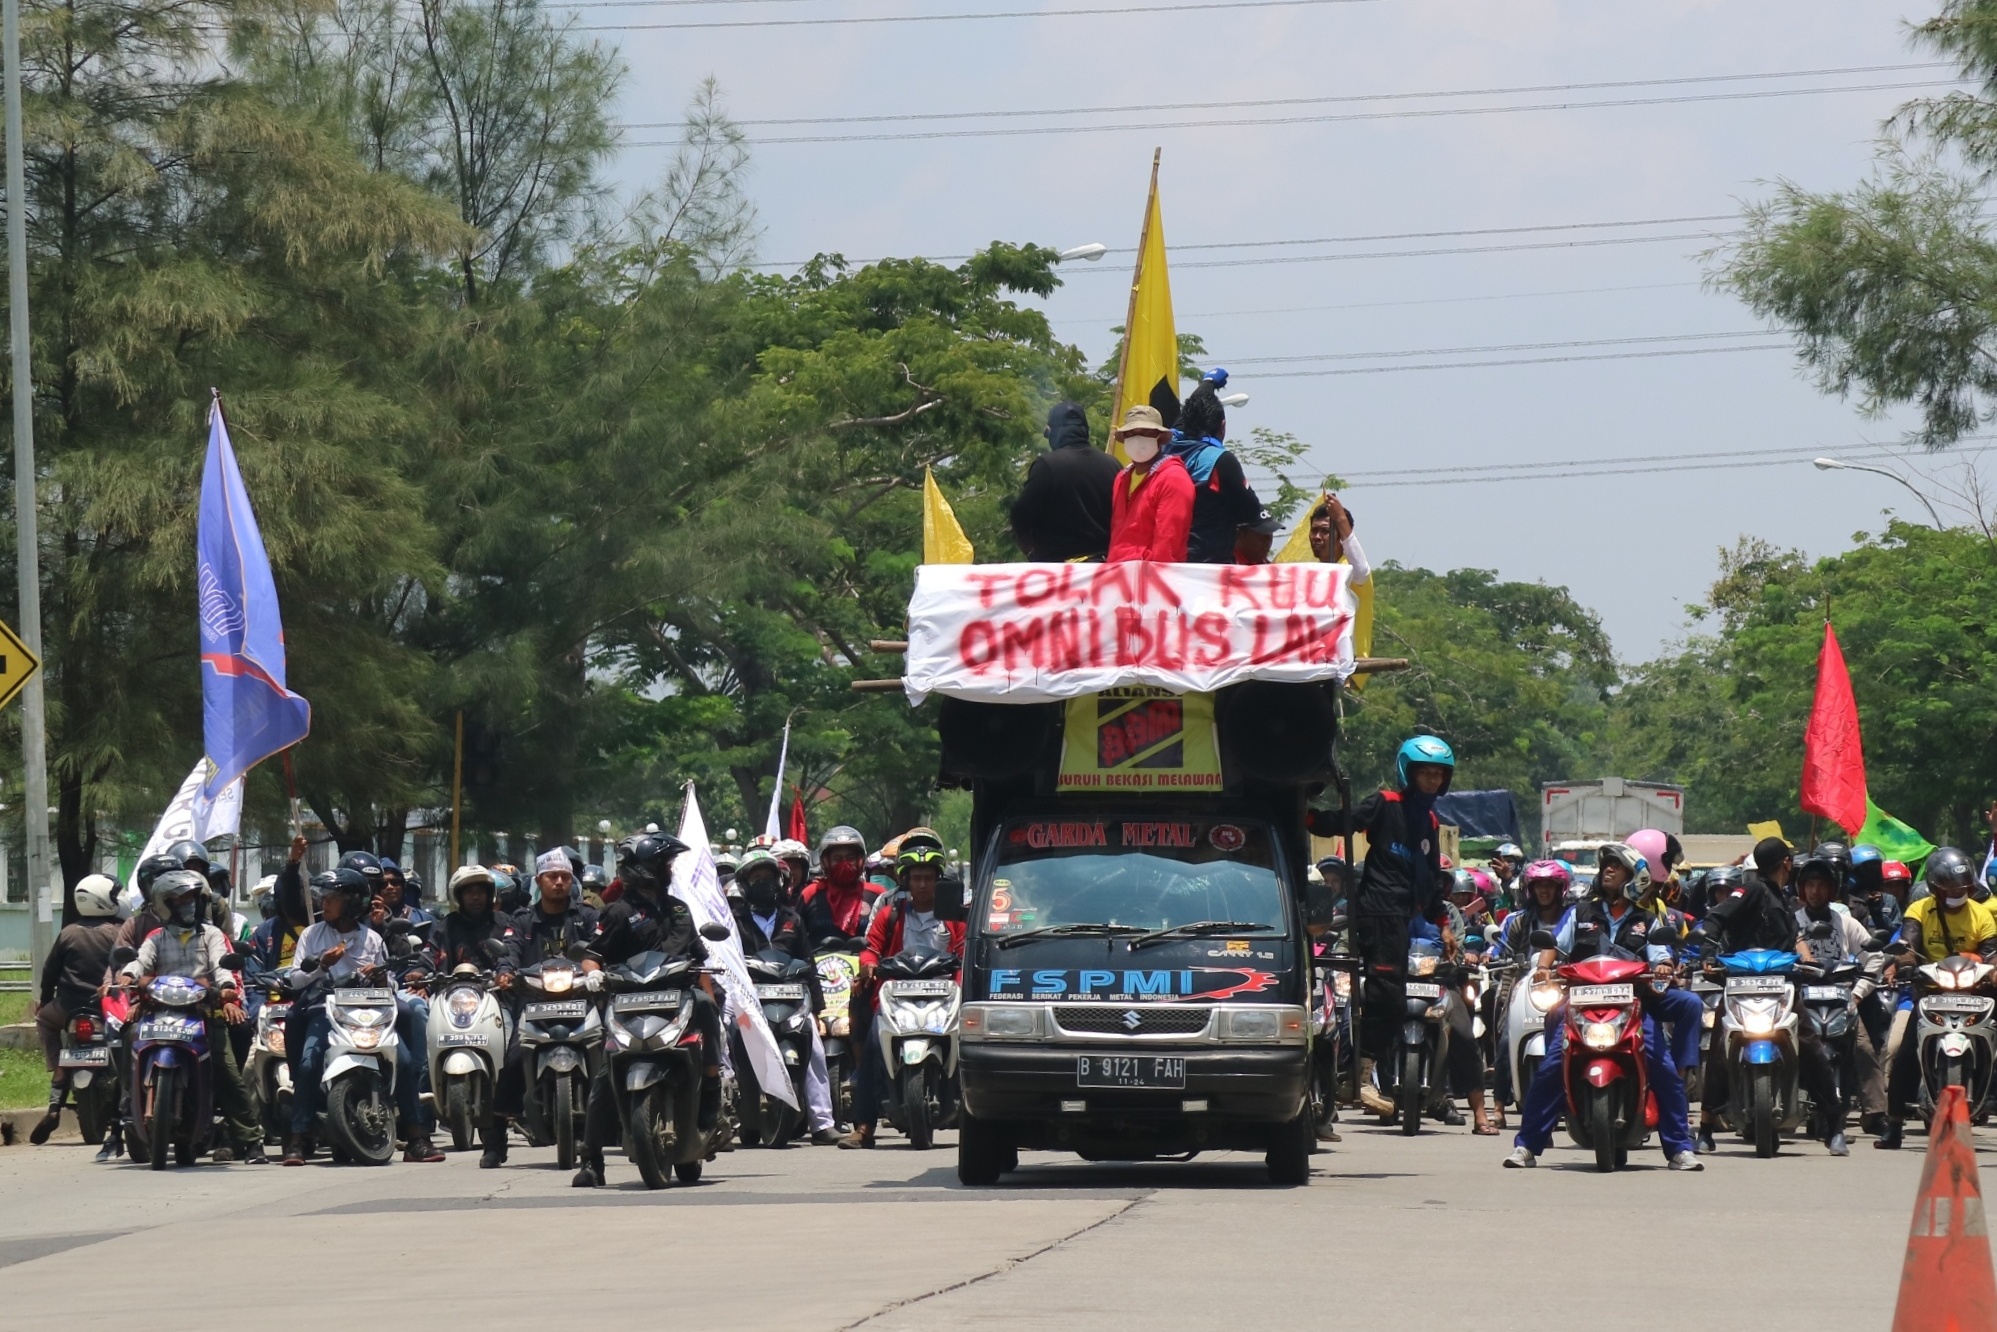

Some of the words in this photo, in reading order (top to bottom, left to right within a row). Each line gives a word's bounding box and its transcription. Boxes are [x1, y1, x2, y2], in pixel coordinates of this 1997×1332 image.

[966, 560, 1182, 609] TOLAK
[958, 606, 1232, 680] OMNIBUS
[1097, 686, 1183, 698] ALIANS
[1106, 773, 1153, 787] BEKASI
[1027, 822, 1107, 848] GARDA
[1121, 822, 1197, 848] METAL
[989, 969, 1193, 995] FSPMI
[1068, 993, 1102, 1001] PEKERJA
[1081, 1058, 1091, 1076] B
[1102, 1059, 1140, 1078] 9121
[1154, 1058, 1184, 1079] FAH
